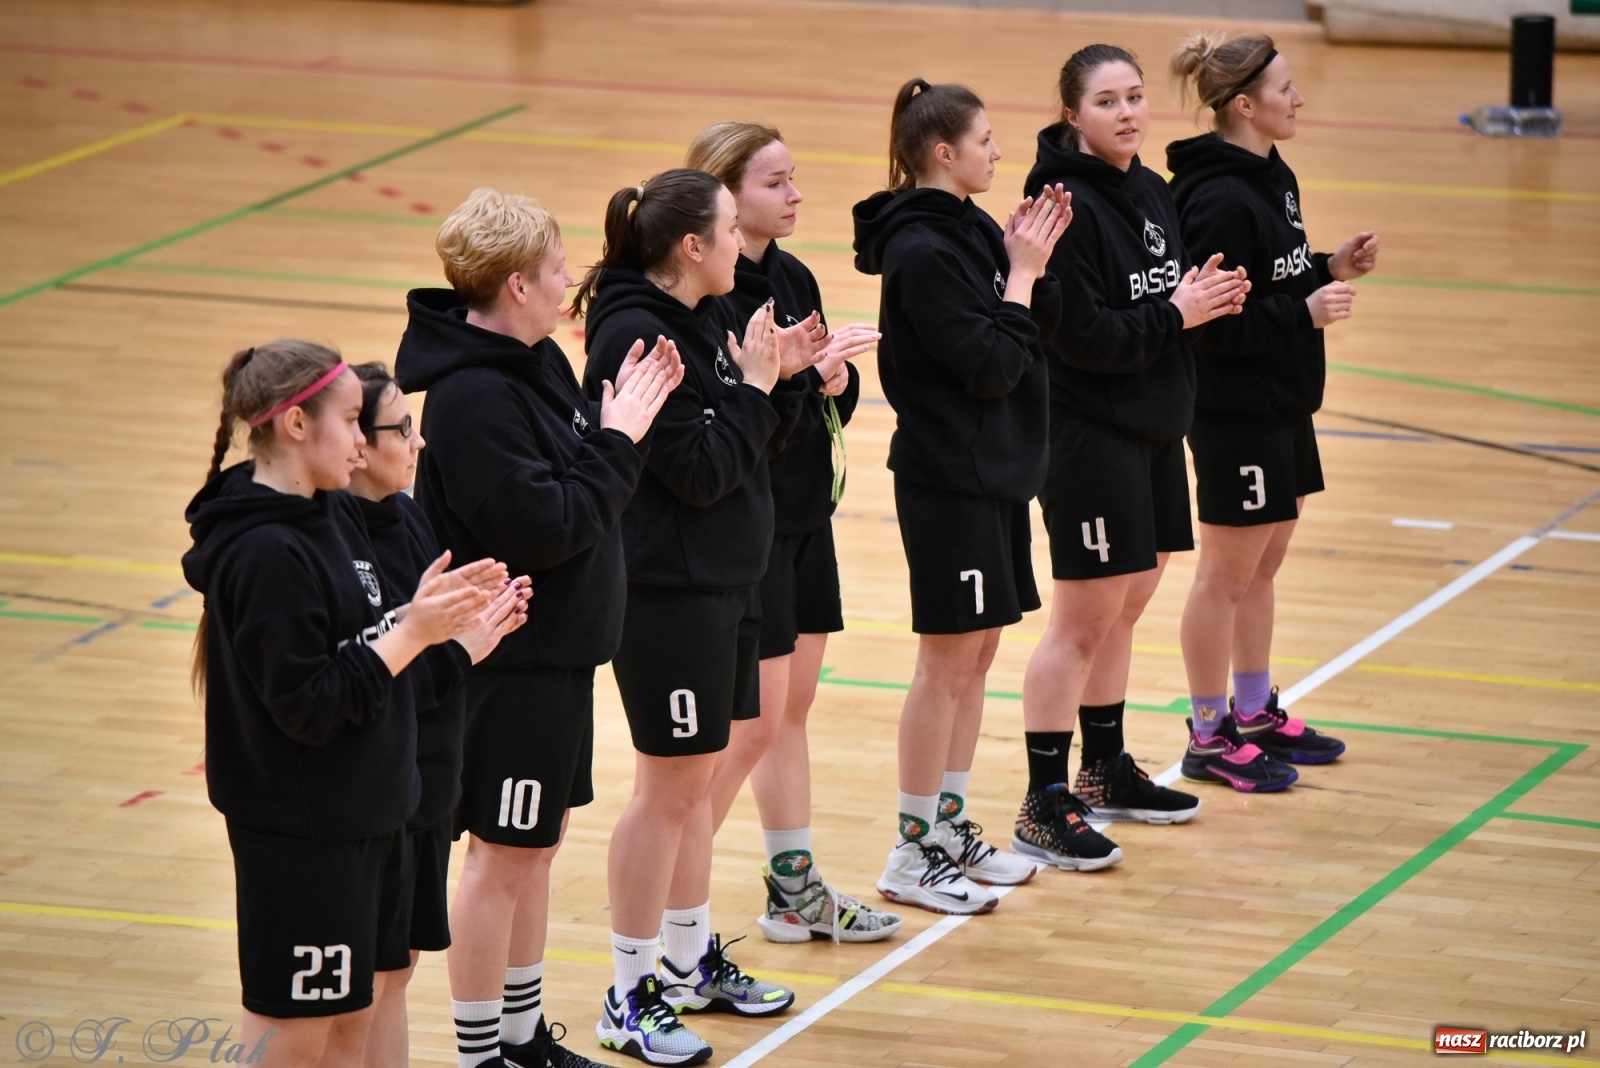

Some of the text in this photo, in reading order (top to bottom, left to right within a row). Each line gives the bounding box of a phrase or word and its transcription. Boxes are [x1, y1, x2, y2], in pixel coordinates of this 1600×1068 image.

[1240, 466, 1265, 510] 3
[1082, 518, 1110, 563] 4
[960, 570, 984, 614] 7
[670, 689, 698, 738] 9
[498, 778, 541, 830] 10
[292, 944, 351, 1001] 23
